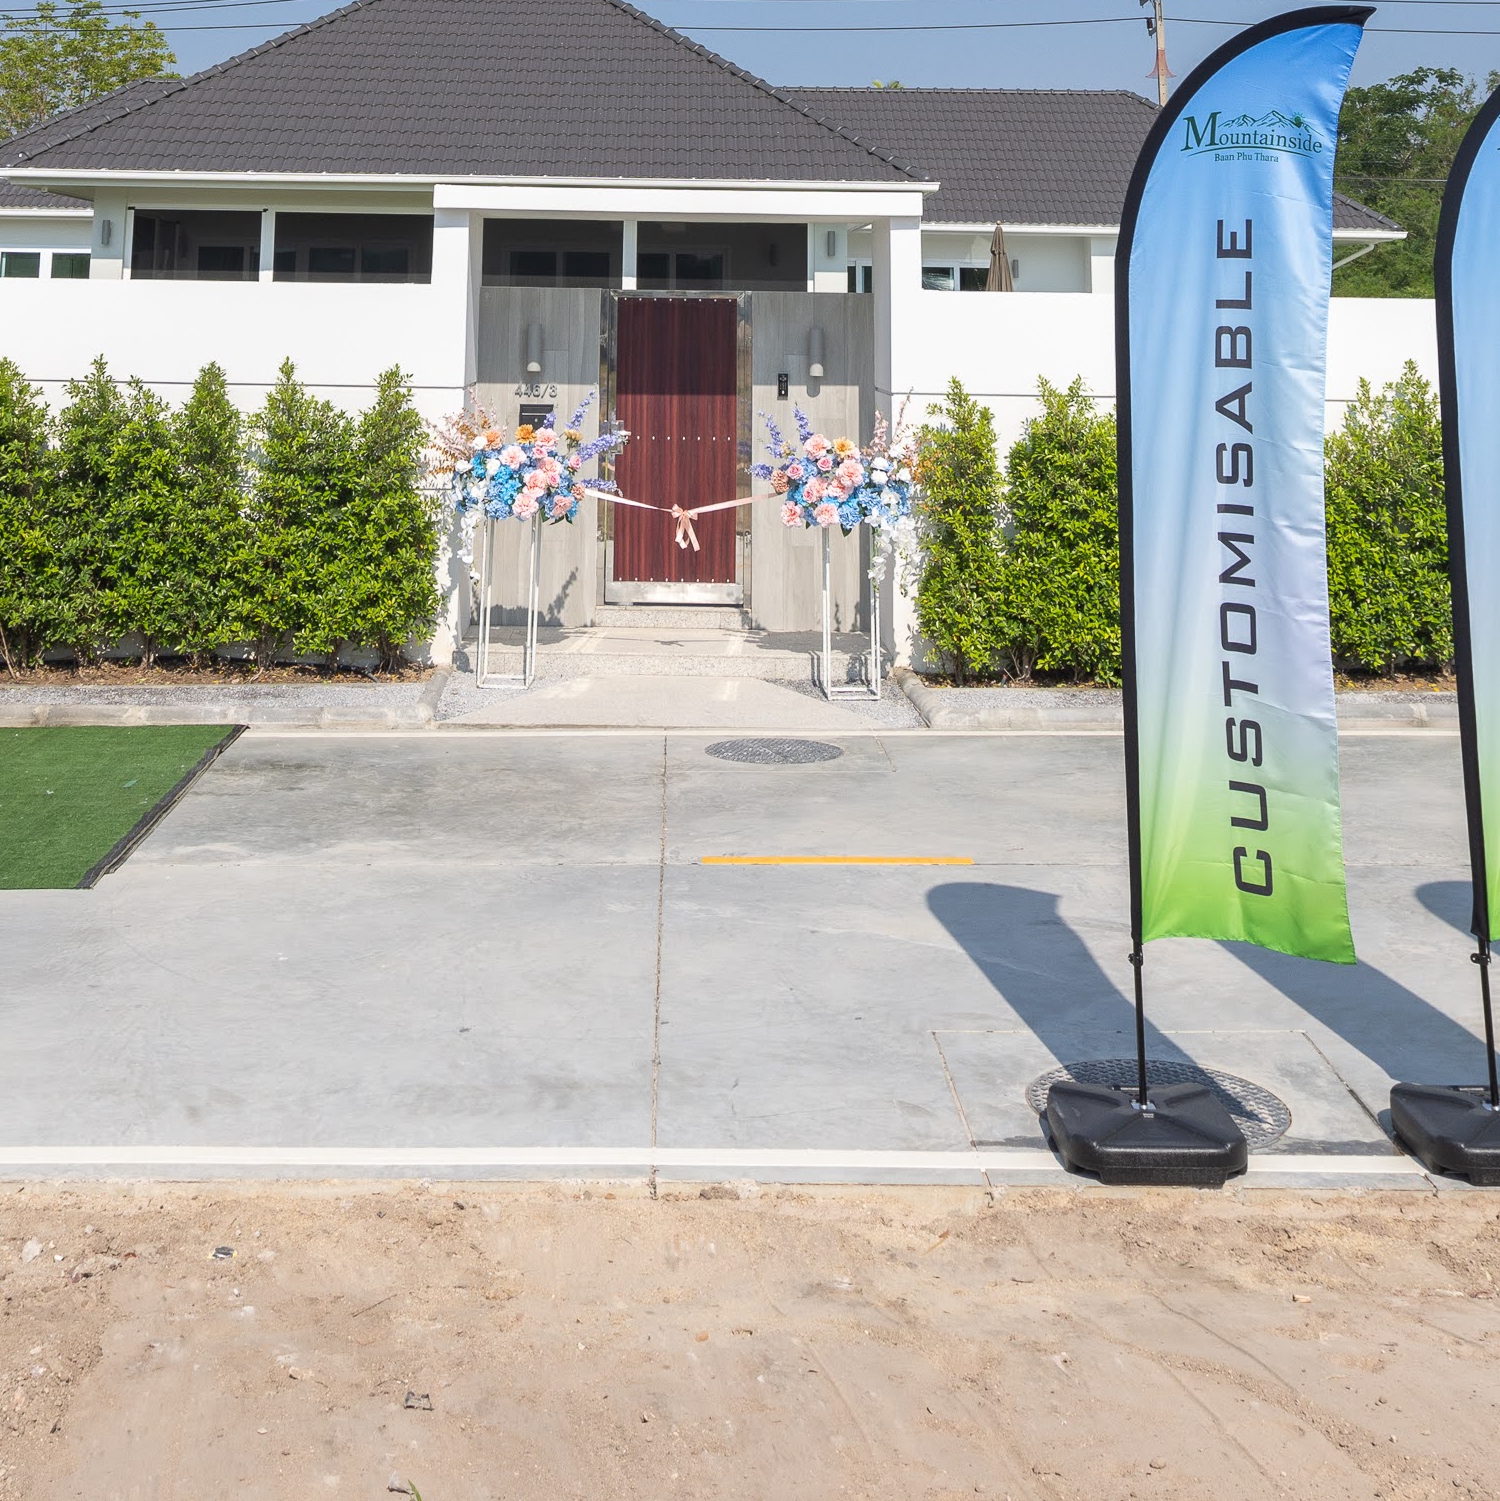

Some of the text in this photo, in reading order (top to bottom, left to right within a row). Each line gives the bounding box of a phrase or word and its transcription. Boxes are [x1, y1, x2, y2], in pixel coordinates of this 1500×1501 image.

[1180, 111, 1323, 153] Mountainside
[1214, 152, 1279, 163] Baan Phu Thara
[1215, 217, 1274, 897] CUSTOMISABLE
